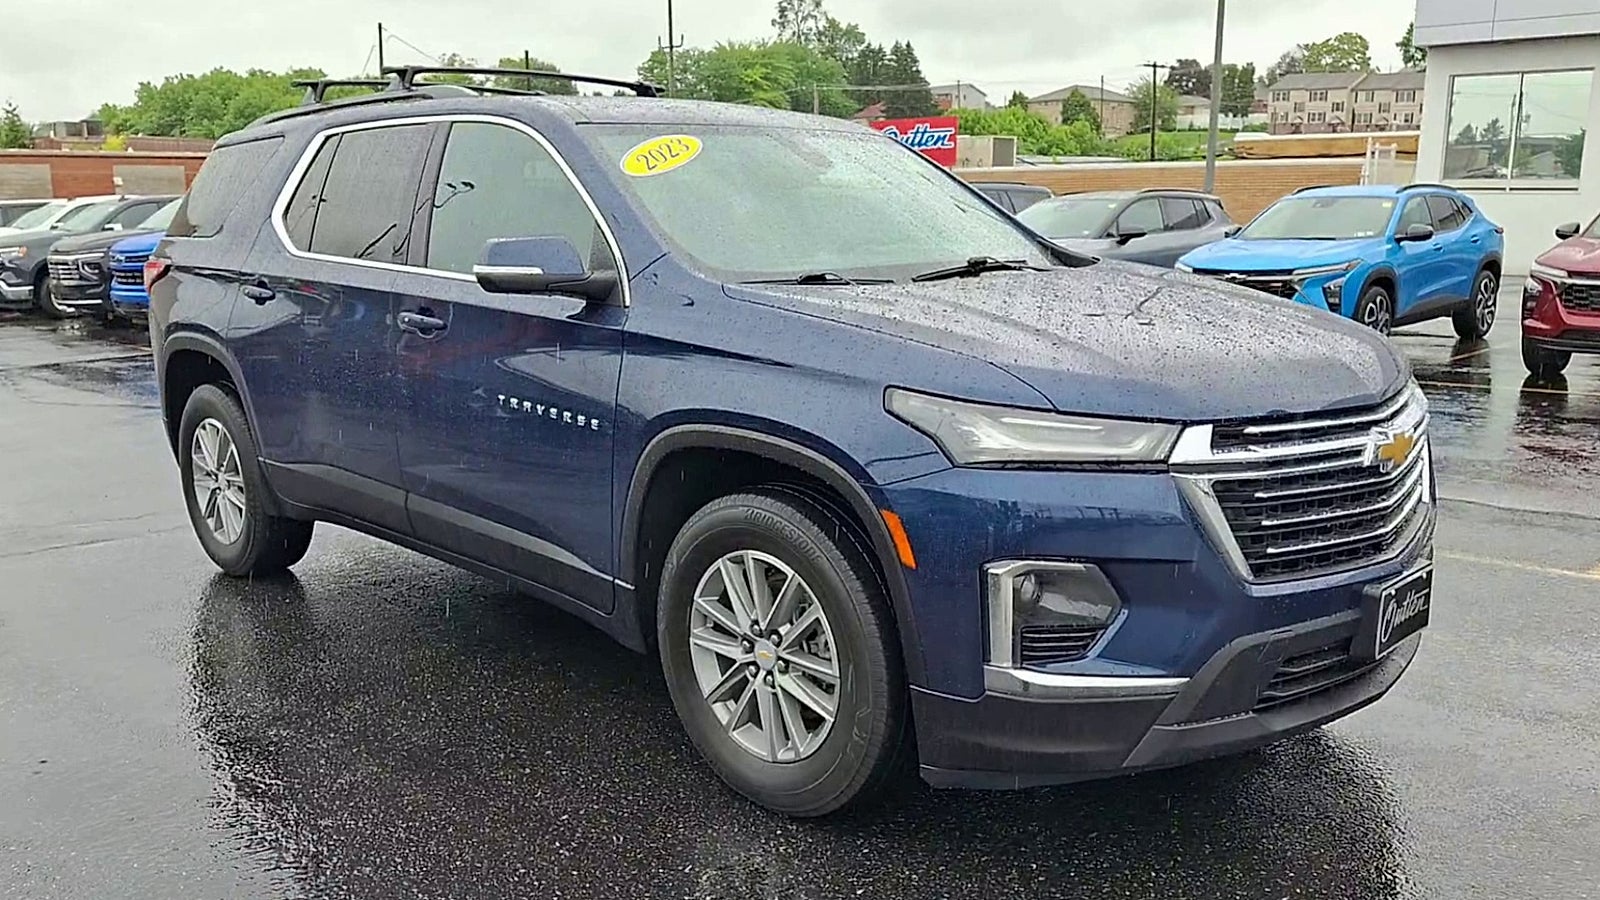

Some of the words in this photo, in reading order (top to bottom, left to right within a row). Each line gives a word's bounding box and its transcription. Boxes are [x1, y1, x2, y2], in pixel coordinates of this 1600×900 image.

[636, 138, 690, 171] 2023
[497, 394, 600, 431] TRAVERSE
[744, 507, 823, 563] BRIDGESTONE
